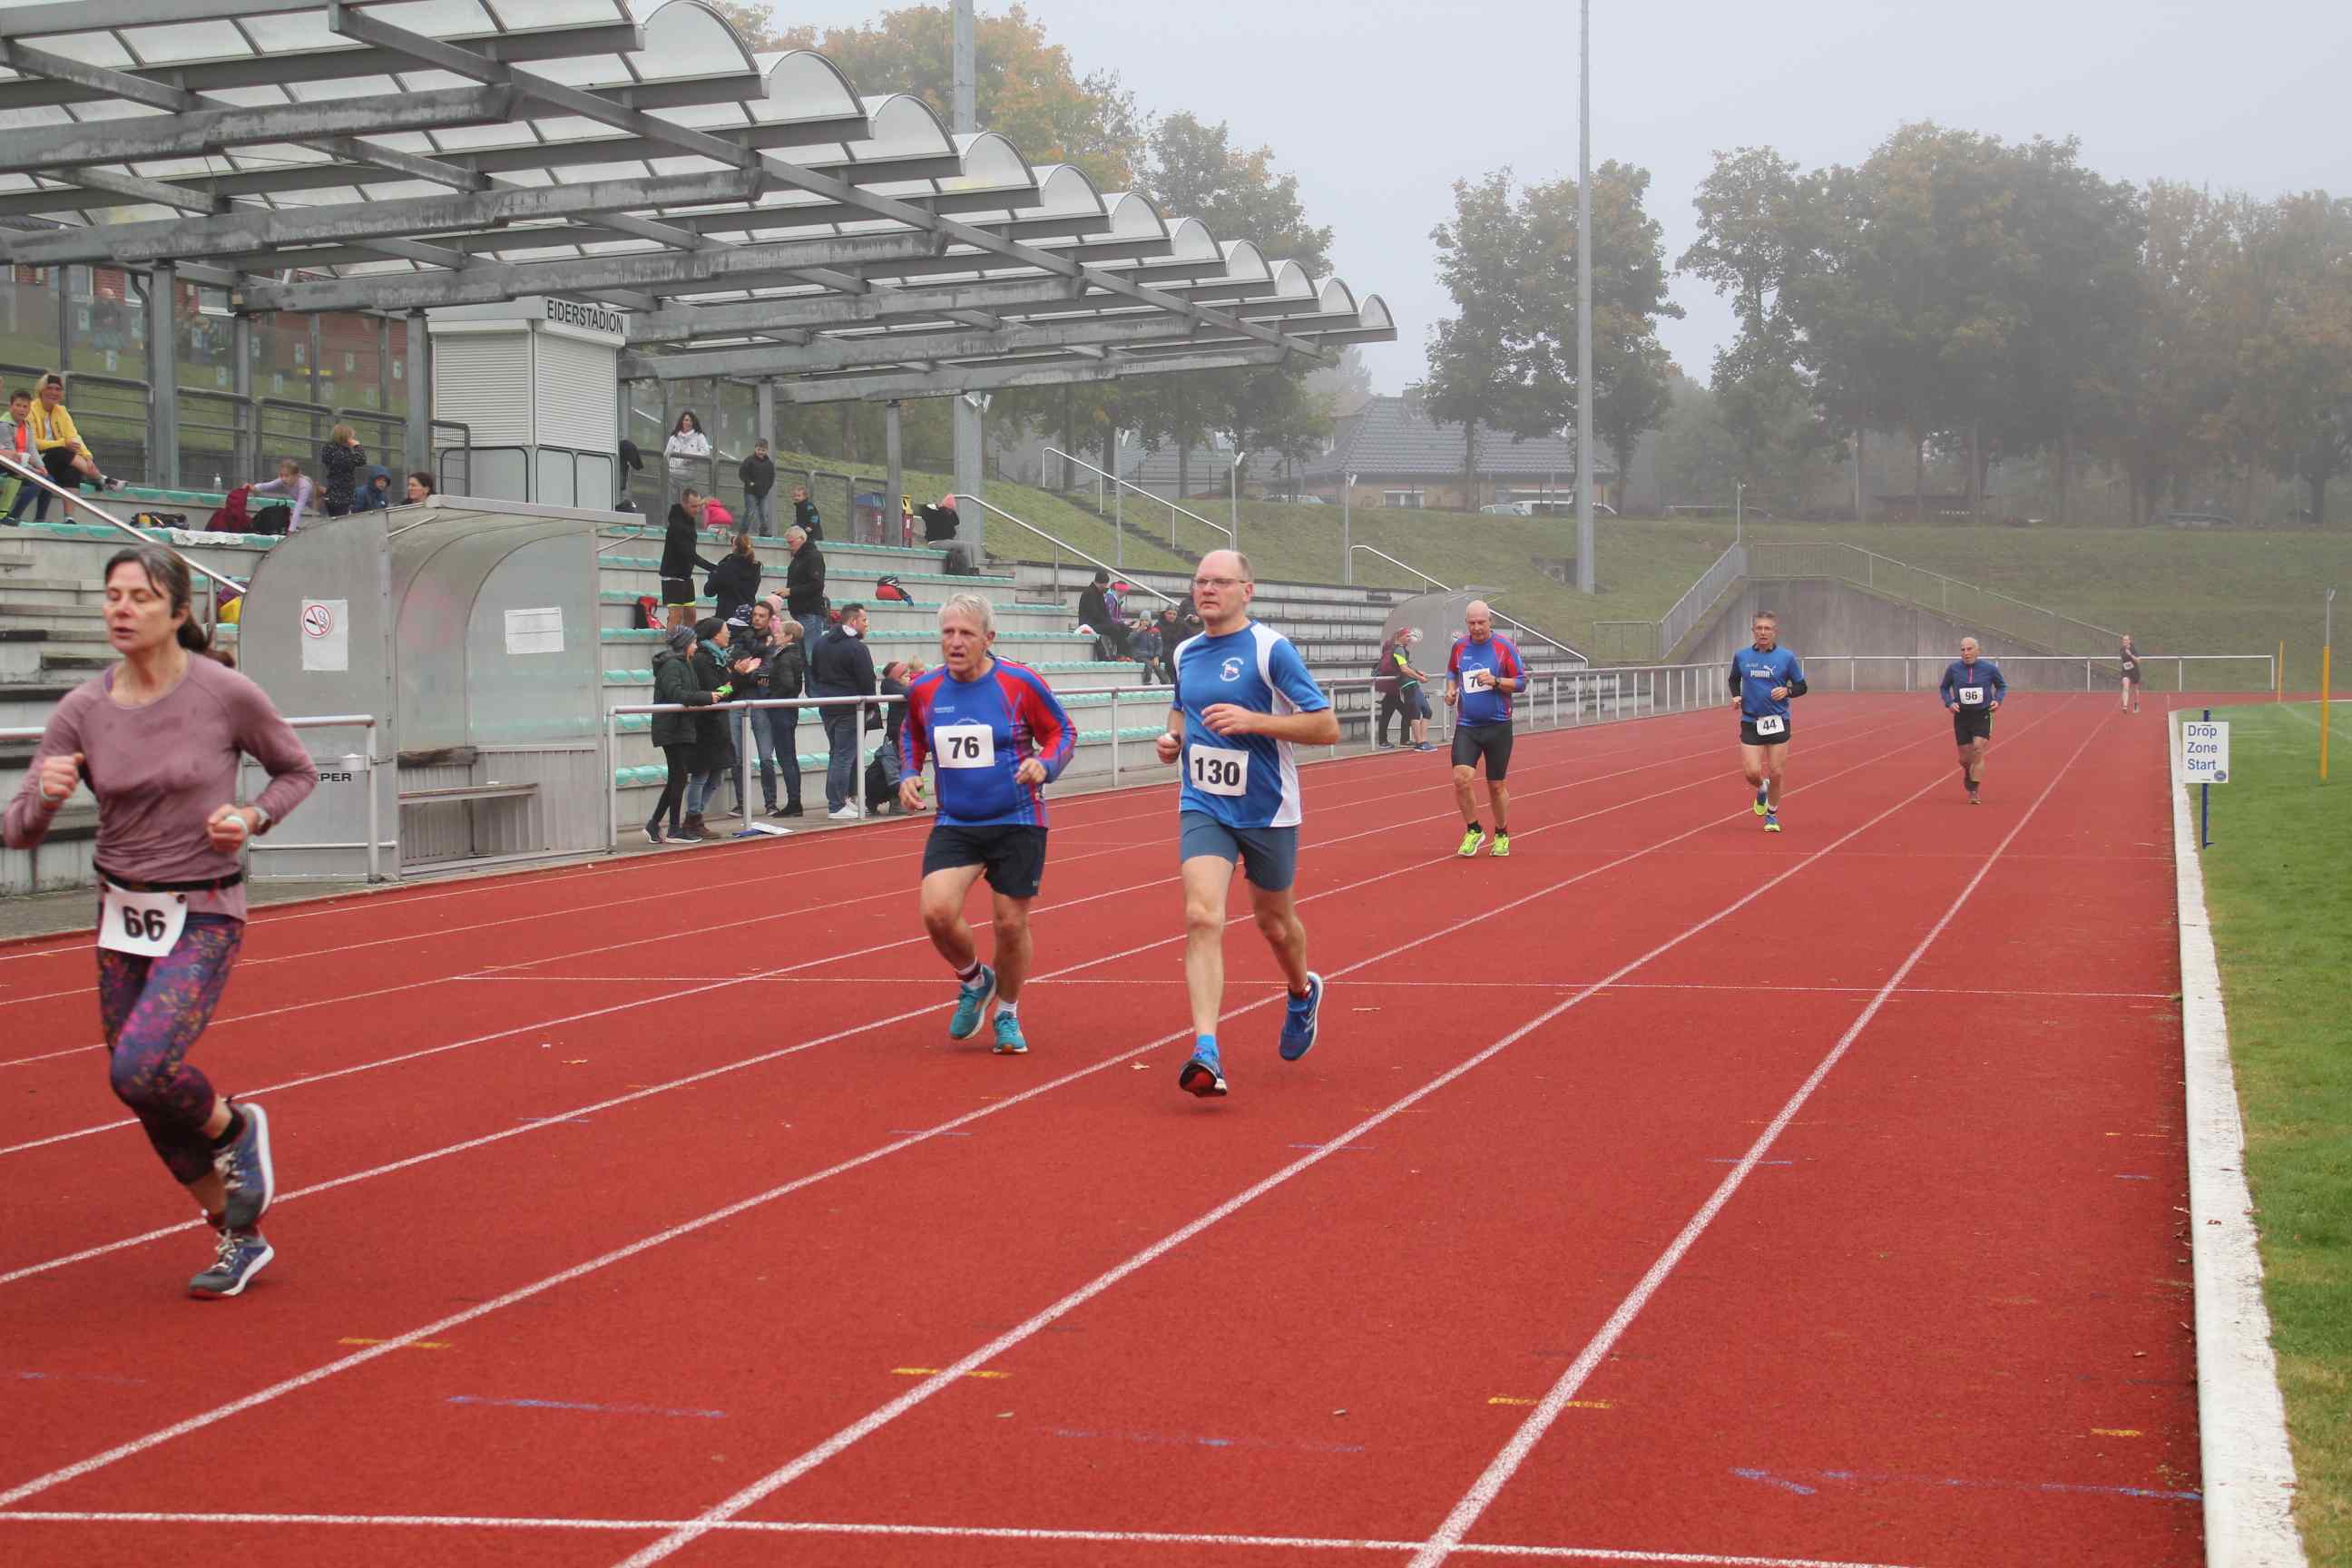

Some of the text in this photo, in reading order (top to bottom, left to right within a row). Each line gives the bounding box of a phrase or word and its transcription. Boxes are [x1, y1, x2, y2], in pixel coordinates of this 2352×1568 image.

[547, 299, 623, 335] EIDERSTADION
[1965, 691, 1978, 701] 96
[1763, 719, 1778, 730] 44
[2188, 725, 2217, 739] Drop
[947, 736, 980, 760] 76
[2188, 741, 2218, 753] Zone
[2188, 759, 2217, 769] Start
[318, 772, 352, 782] PER
[1194, 757, 1240, 787] 130
[122, 906, 167, 942] 66
